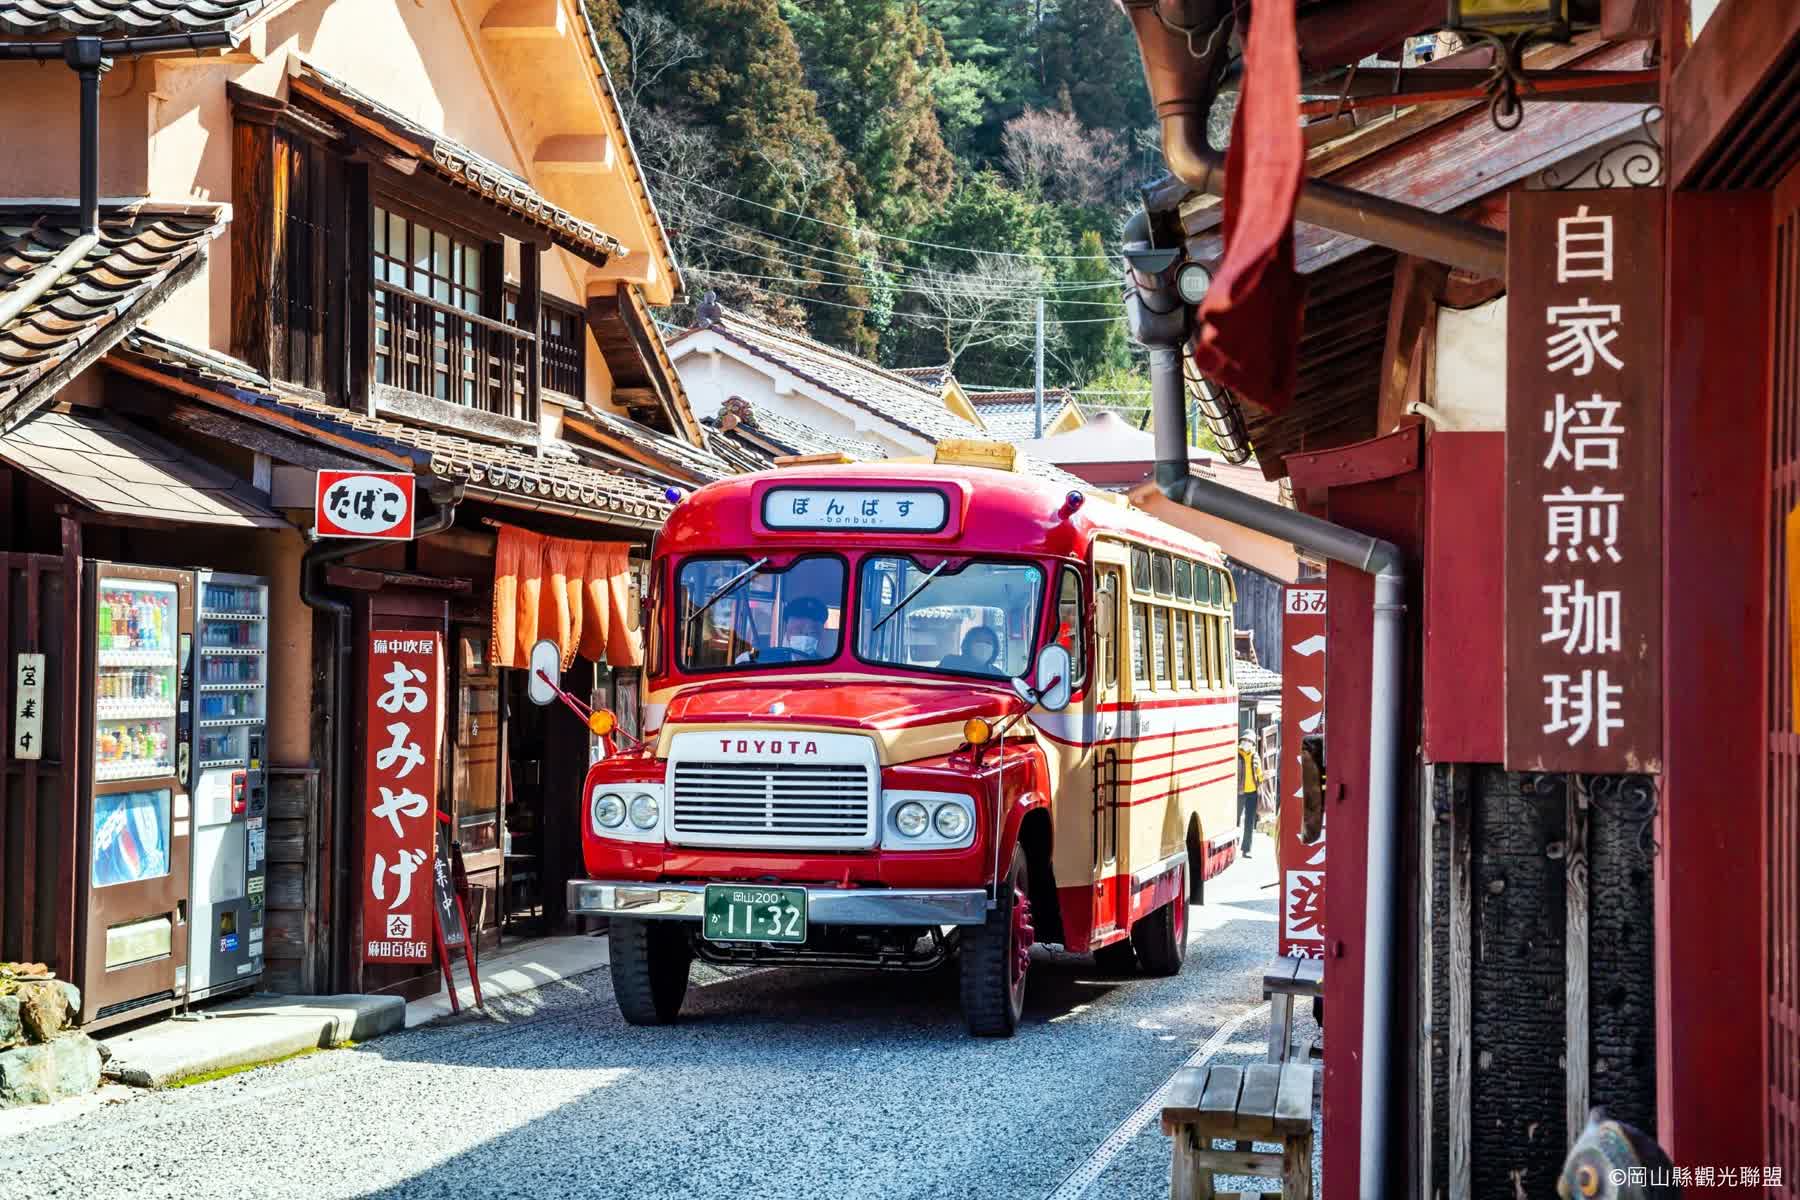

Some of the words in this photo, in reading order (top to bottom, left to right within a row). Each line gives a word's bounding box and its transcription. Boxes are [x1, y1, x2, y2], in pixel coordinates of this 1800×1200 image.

[1542, 205, 1625, 747] 自家焙煎珈琲
[330, 485, 399, 522] たばこ
[792, 497, 914, 517] ぼんばす
[373, 639, 434, 654] 備中吹屋
[720, 740, 818, 754] TOYOTA
[371, 661, 429, 910] おみやげ
[728, 903, 800, 937] 11-32
